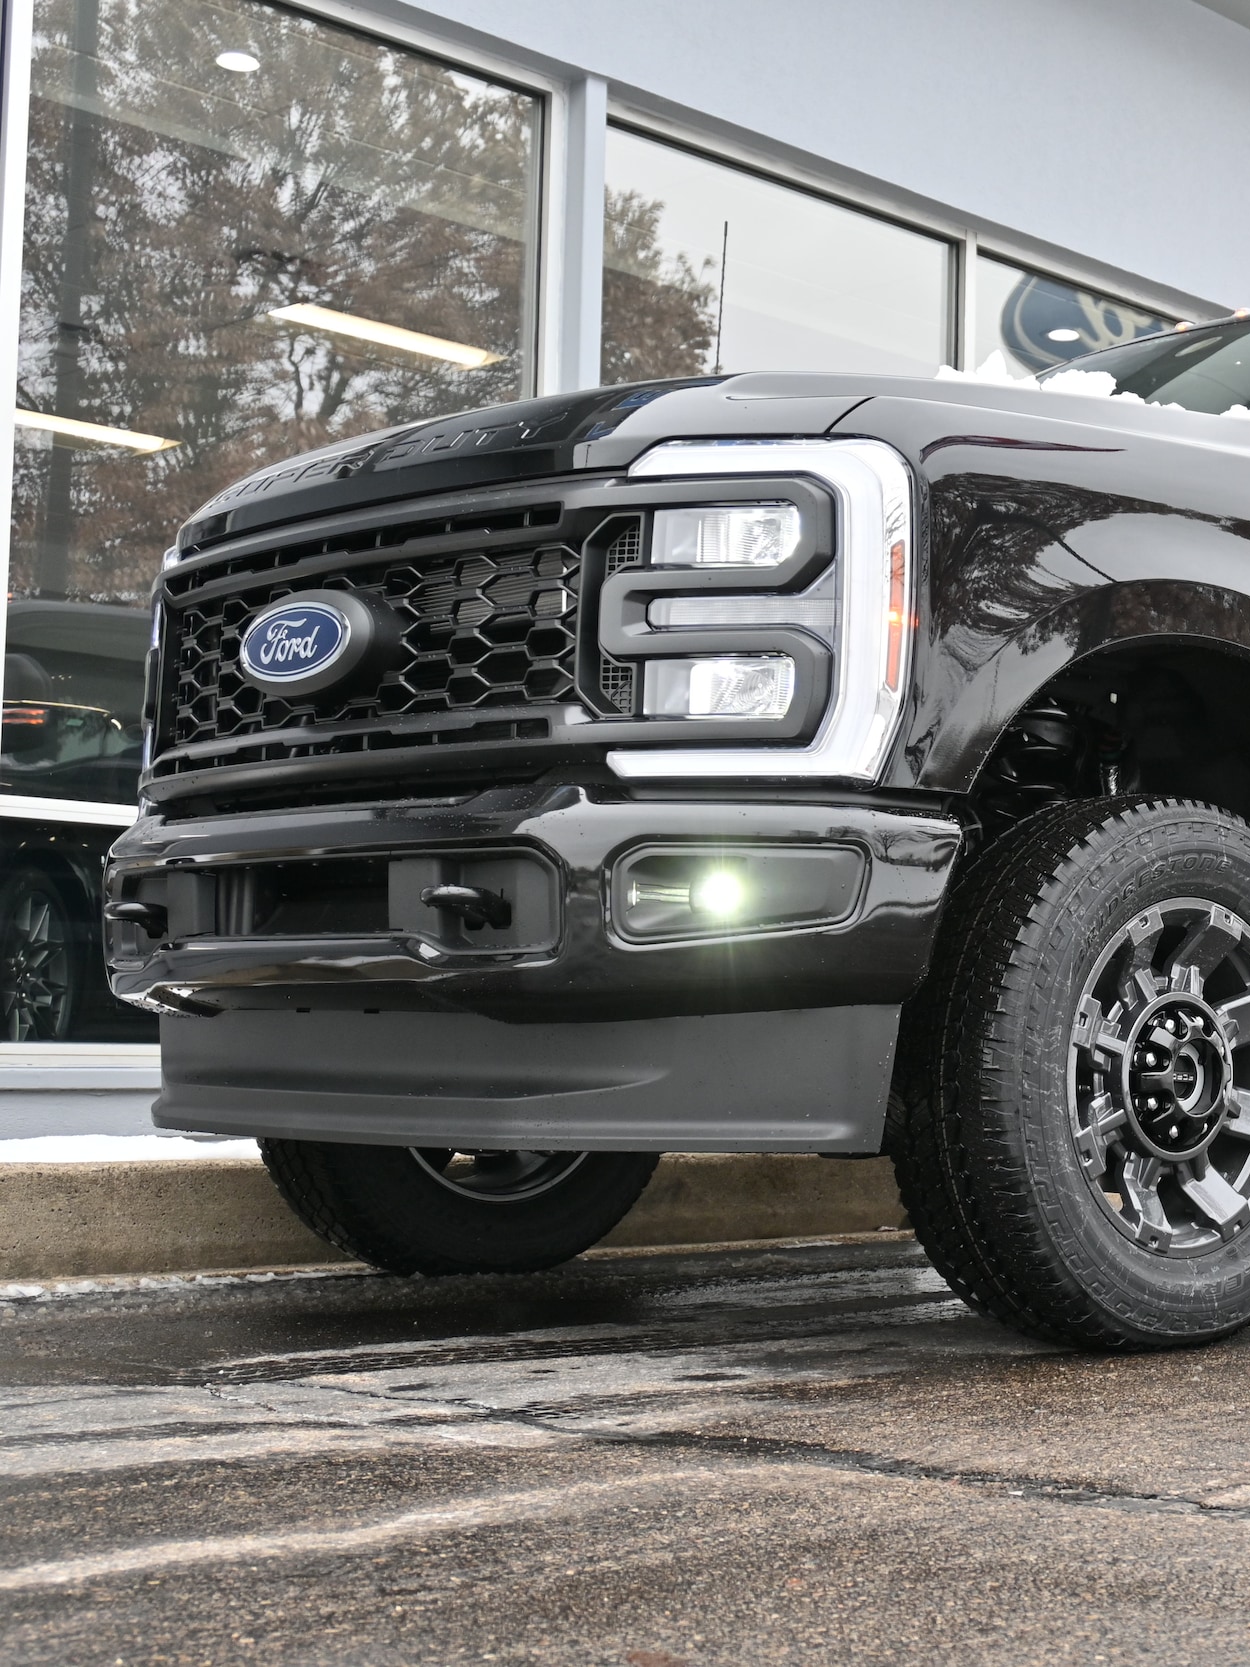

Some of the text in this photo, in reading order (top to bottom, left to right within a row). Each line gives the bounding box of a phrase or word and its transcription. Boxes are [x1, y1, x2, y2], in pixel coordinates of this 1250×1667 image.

[206, 412, 568, 509] SUPER DUTY
[261, 618, 320, 665] Ford
[1073, 853, 1232, 966] BRIDGESTONE
